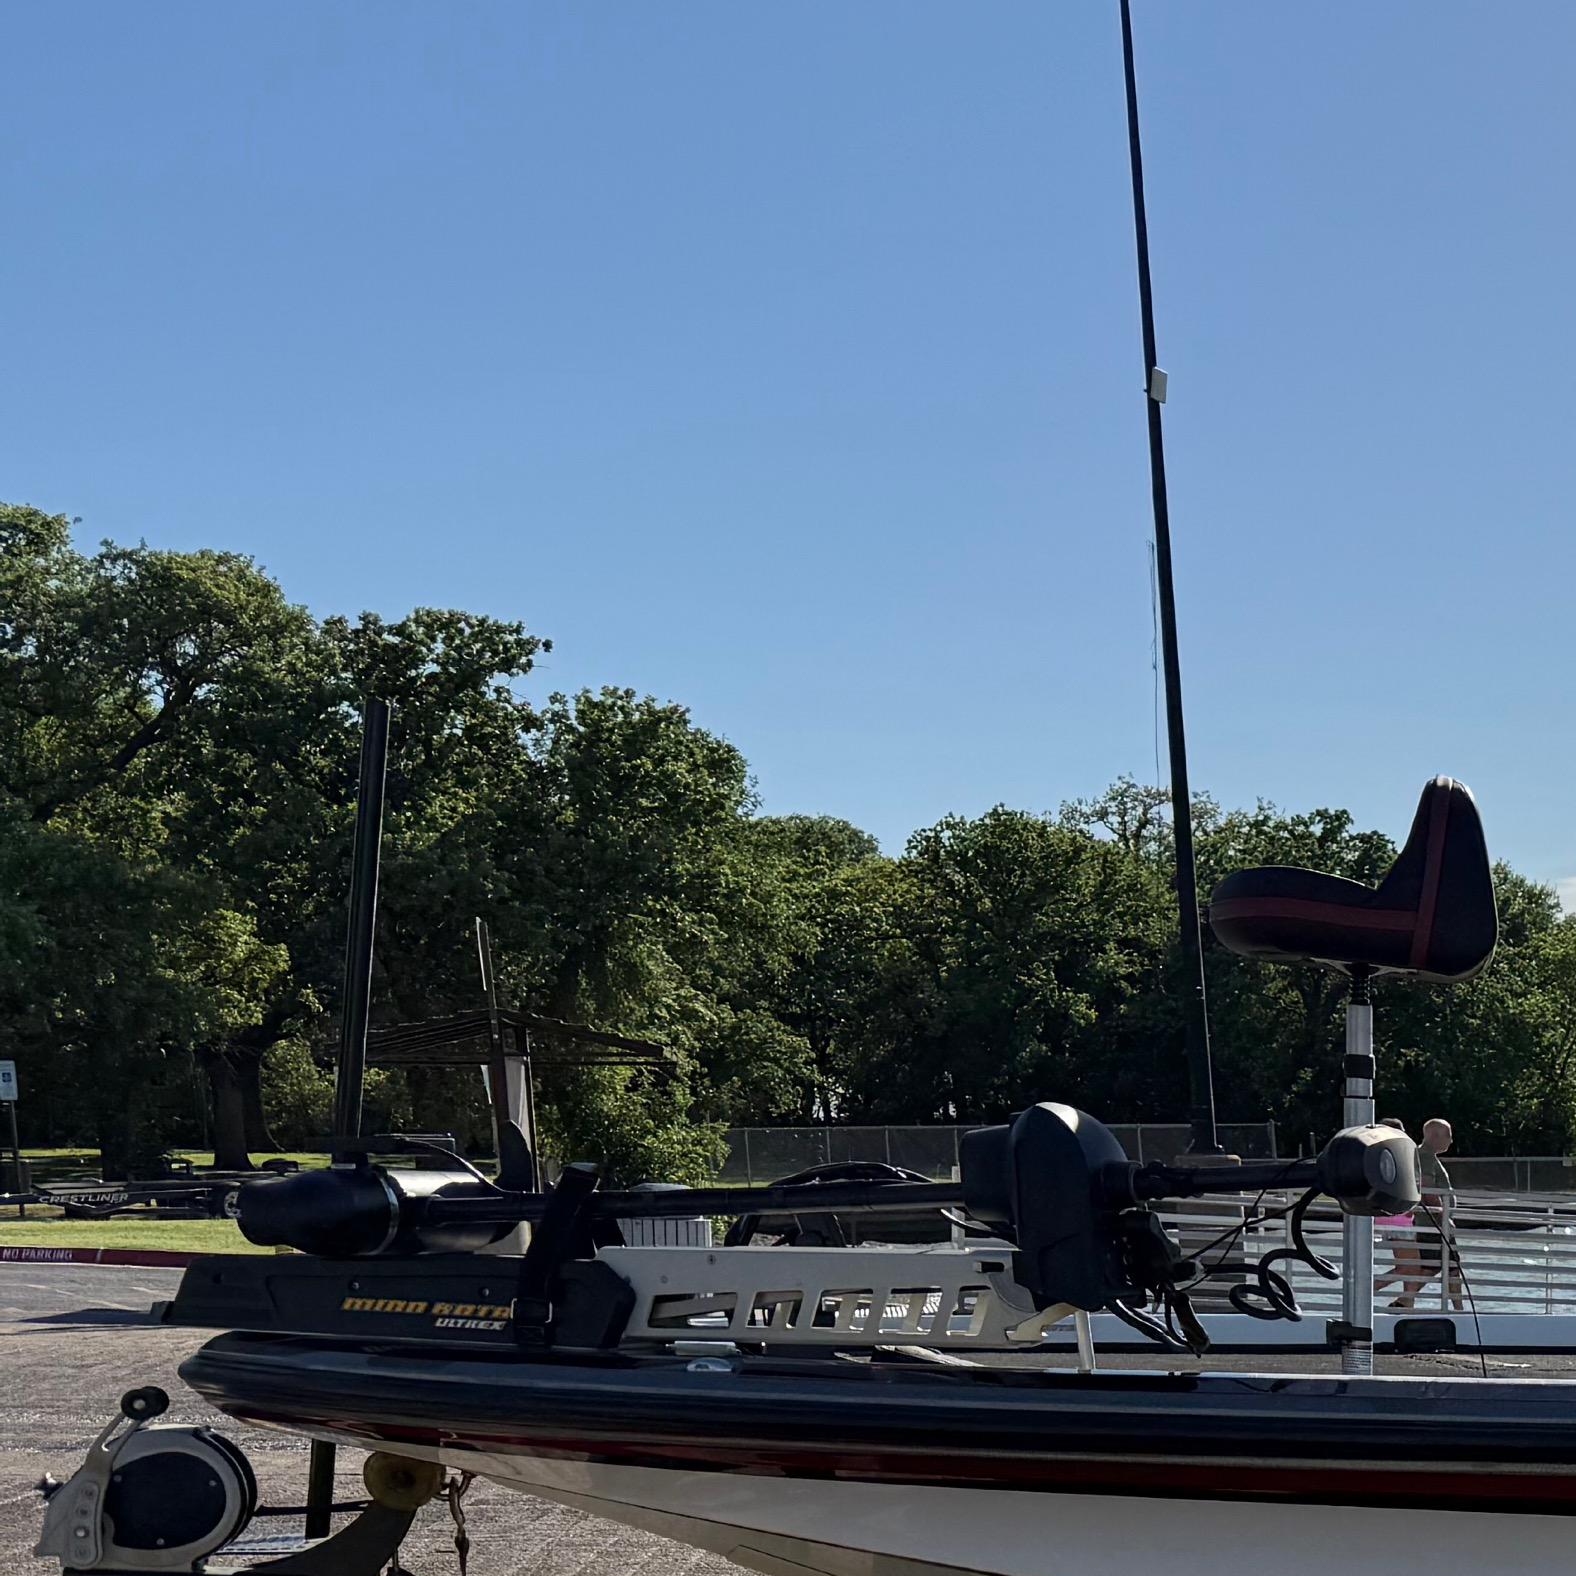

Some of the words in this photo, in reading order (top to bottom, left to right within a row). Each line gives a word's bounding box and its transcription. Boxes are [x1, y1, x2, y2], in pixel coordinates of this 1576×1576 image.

[39, 1192, 129, 1204] CRESTLINER
[2, 1248, 19, 1259] NO
[21, 1248, 73, 1260] PARKING
[434, 1317, 507, 1331] ULTREX
